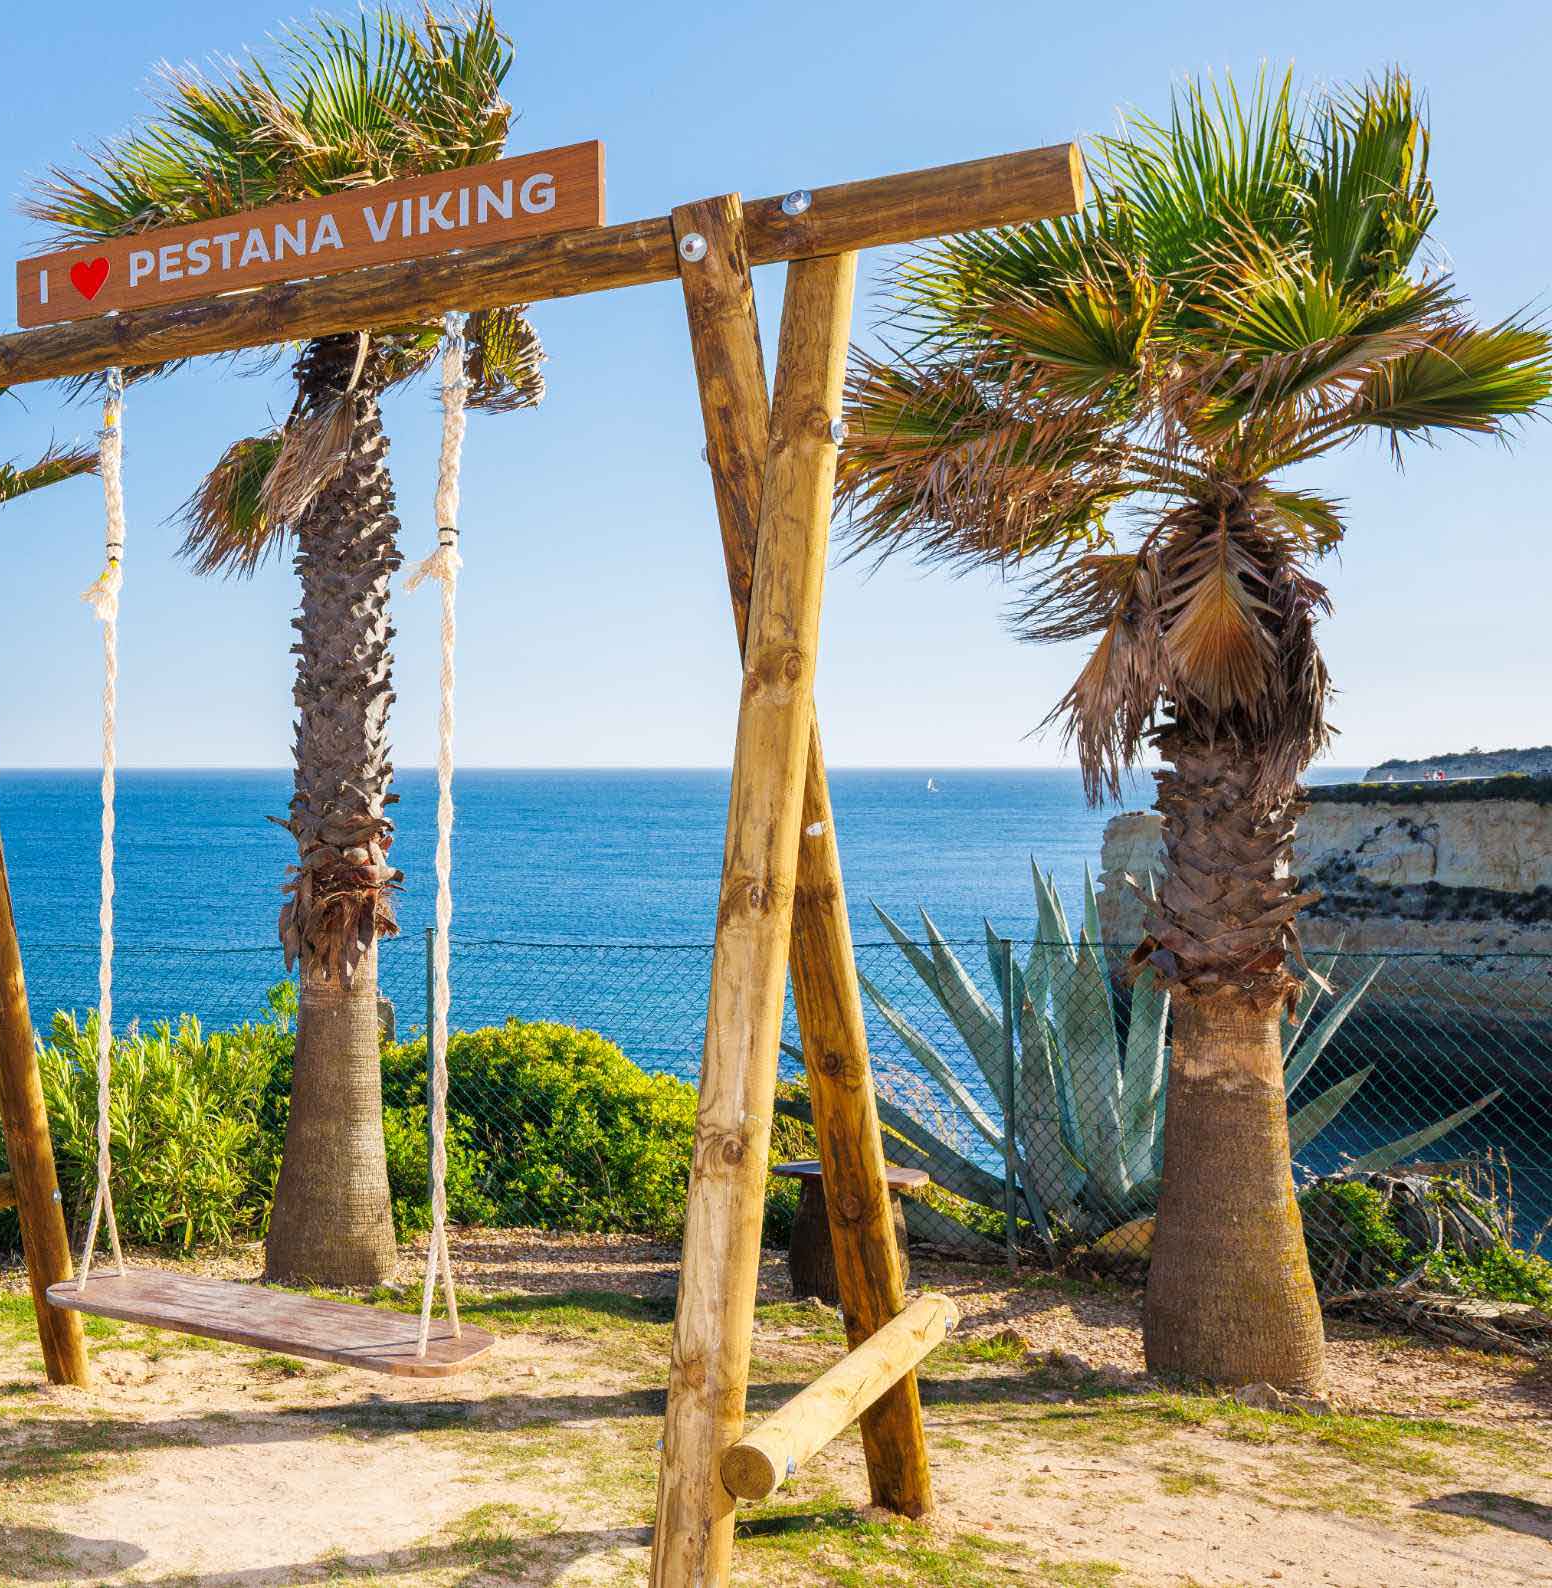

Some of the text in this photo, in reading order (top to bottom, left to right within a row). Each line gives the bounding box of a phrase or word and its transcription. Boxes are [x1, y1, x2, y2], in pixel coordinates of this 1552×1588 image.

[39, 173, 556, 305] I PESTANA VIKING
